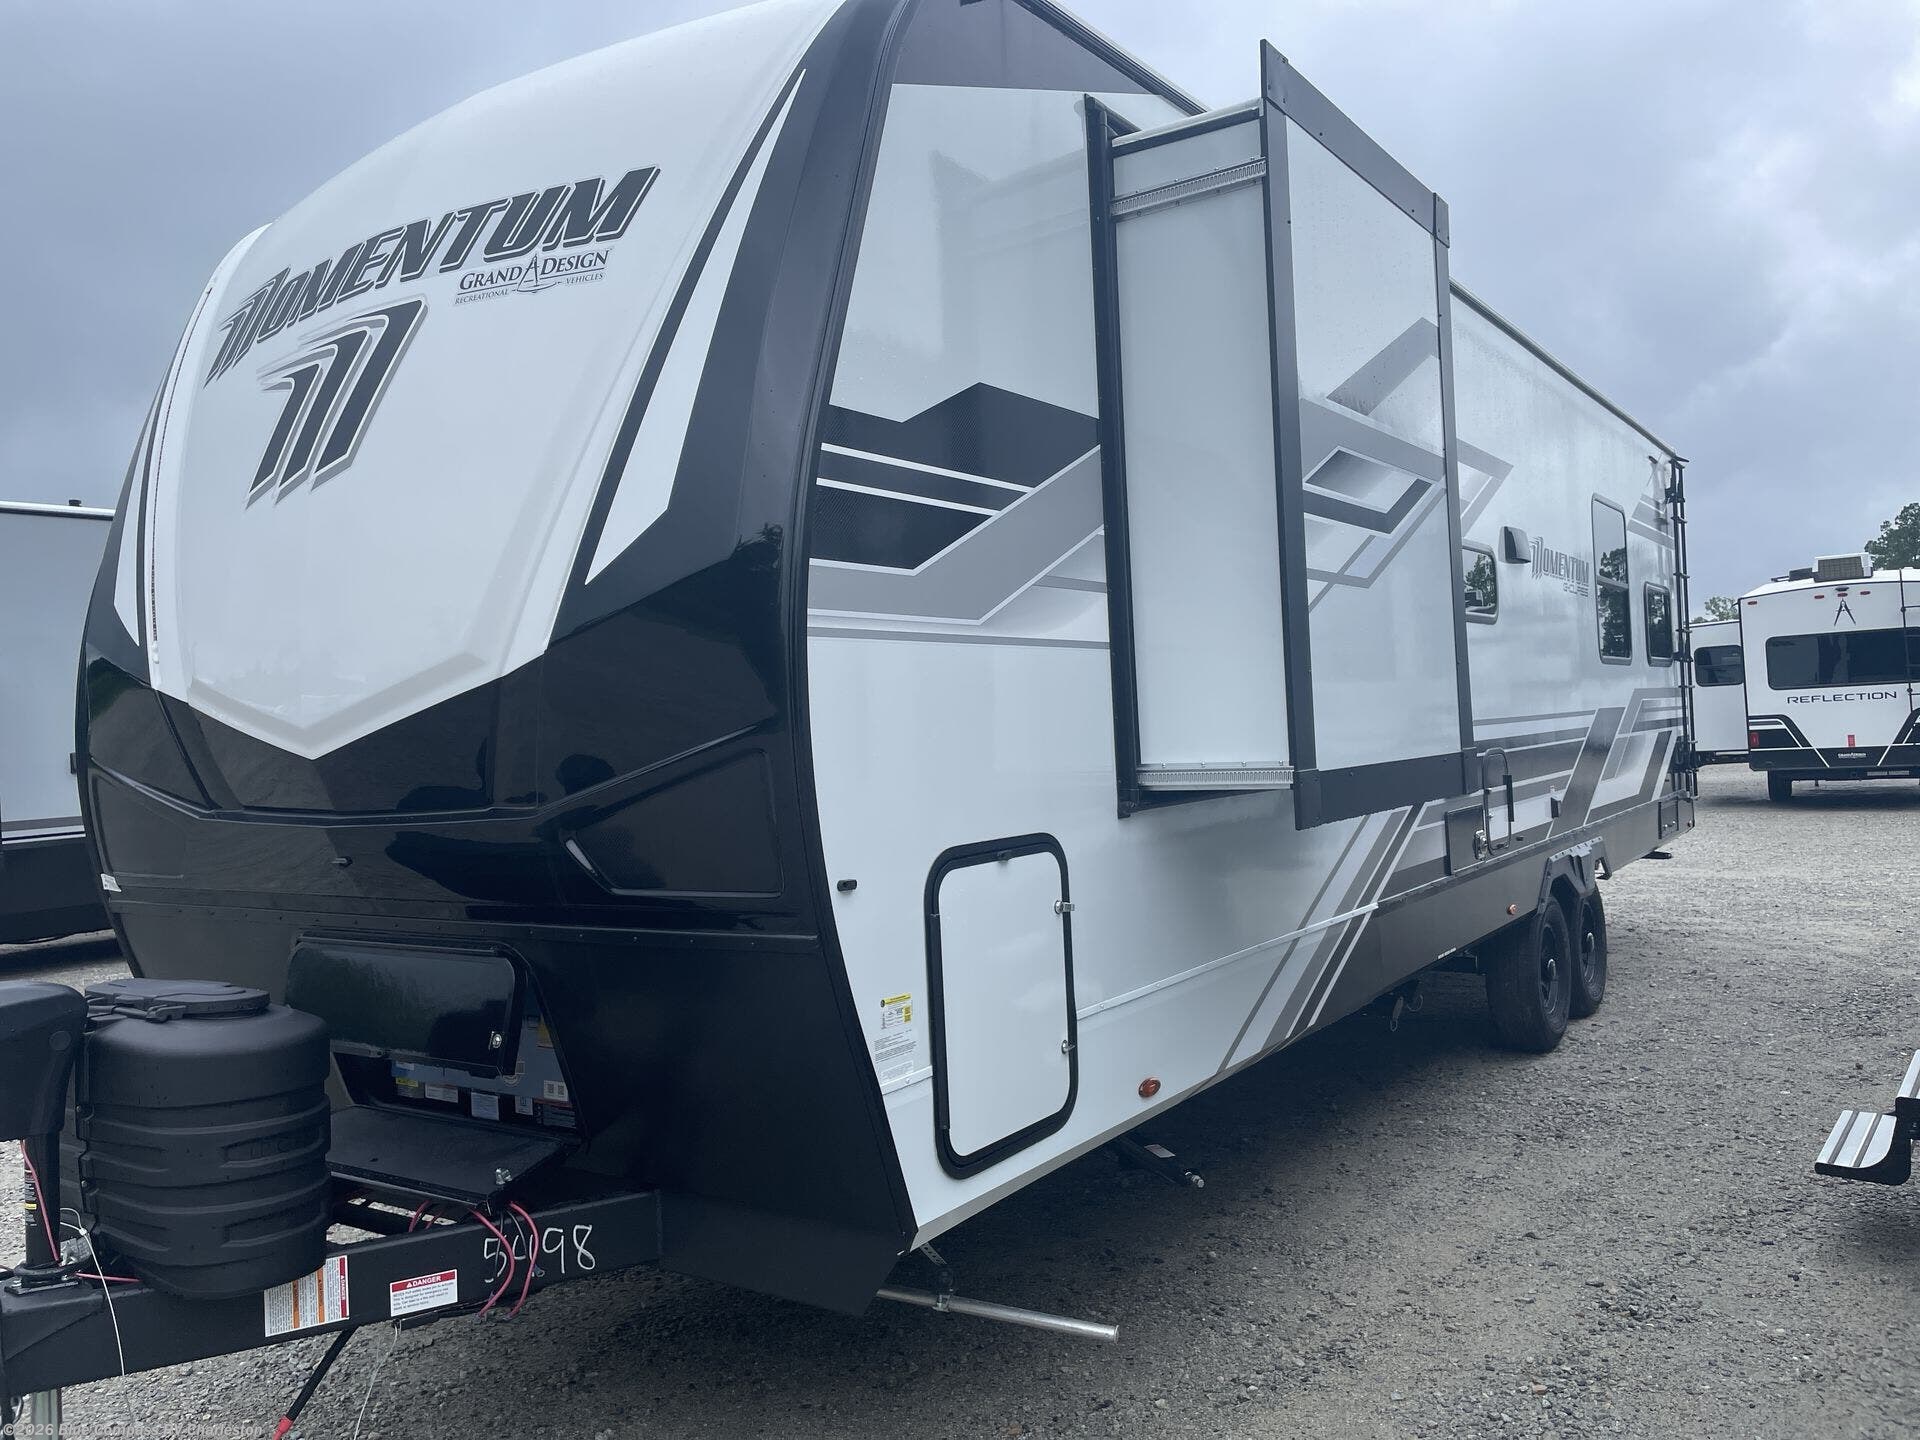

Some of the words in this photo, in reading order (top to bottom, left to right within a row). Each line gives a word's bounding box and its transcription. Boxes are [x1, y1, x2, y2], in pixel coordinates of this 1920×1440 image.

[203, 165, 661, 389] MOMENTUM
[459, 266, 523, 290] GRAND
[540, 249, 609, 276] DESIGN
[454, 288, 510, 305] RECREATIONAL
[565, 272, 604, 285] VEHICLES
[1787, 691, 1897, 704] REFLECTION
[412, 1275, 442, 1287] DANGER
